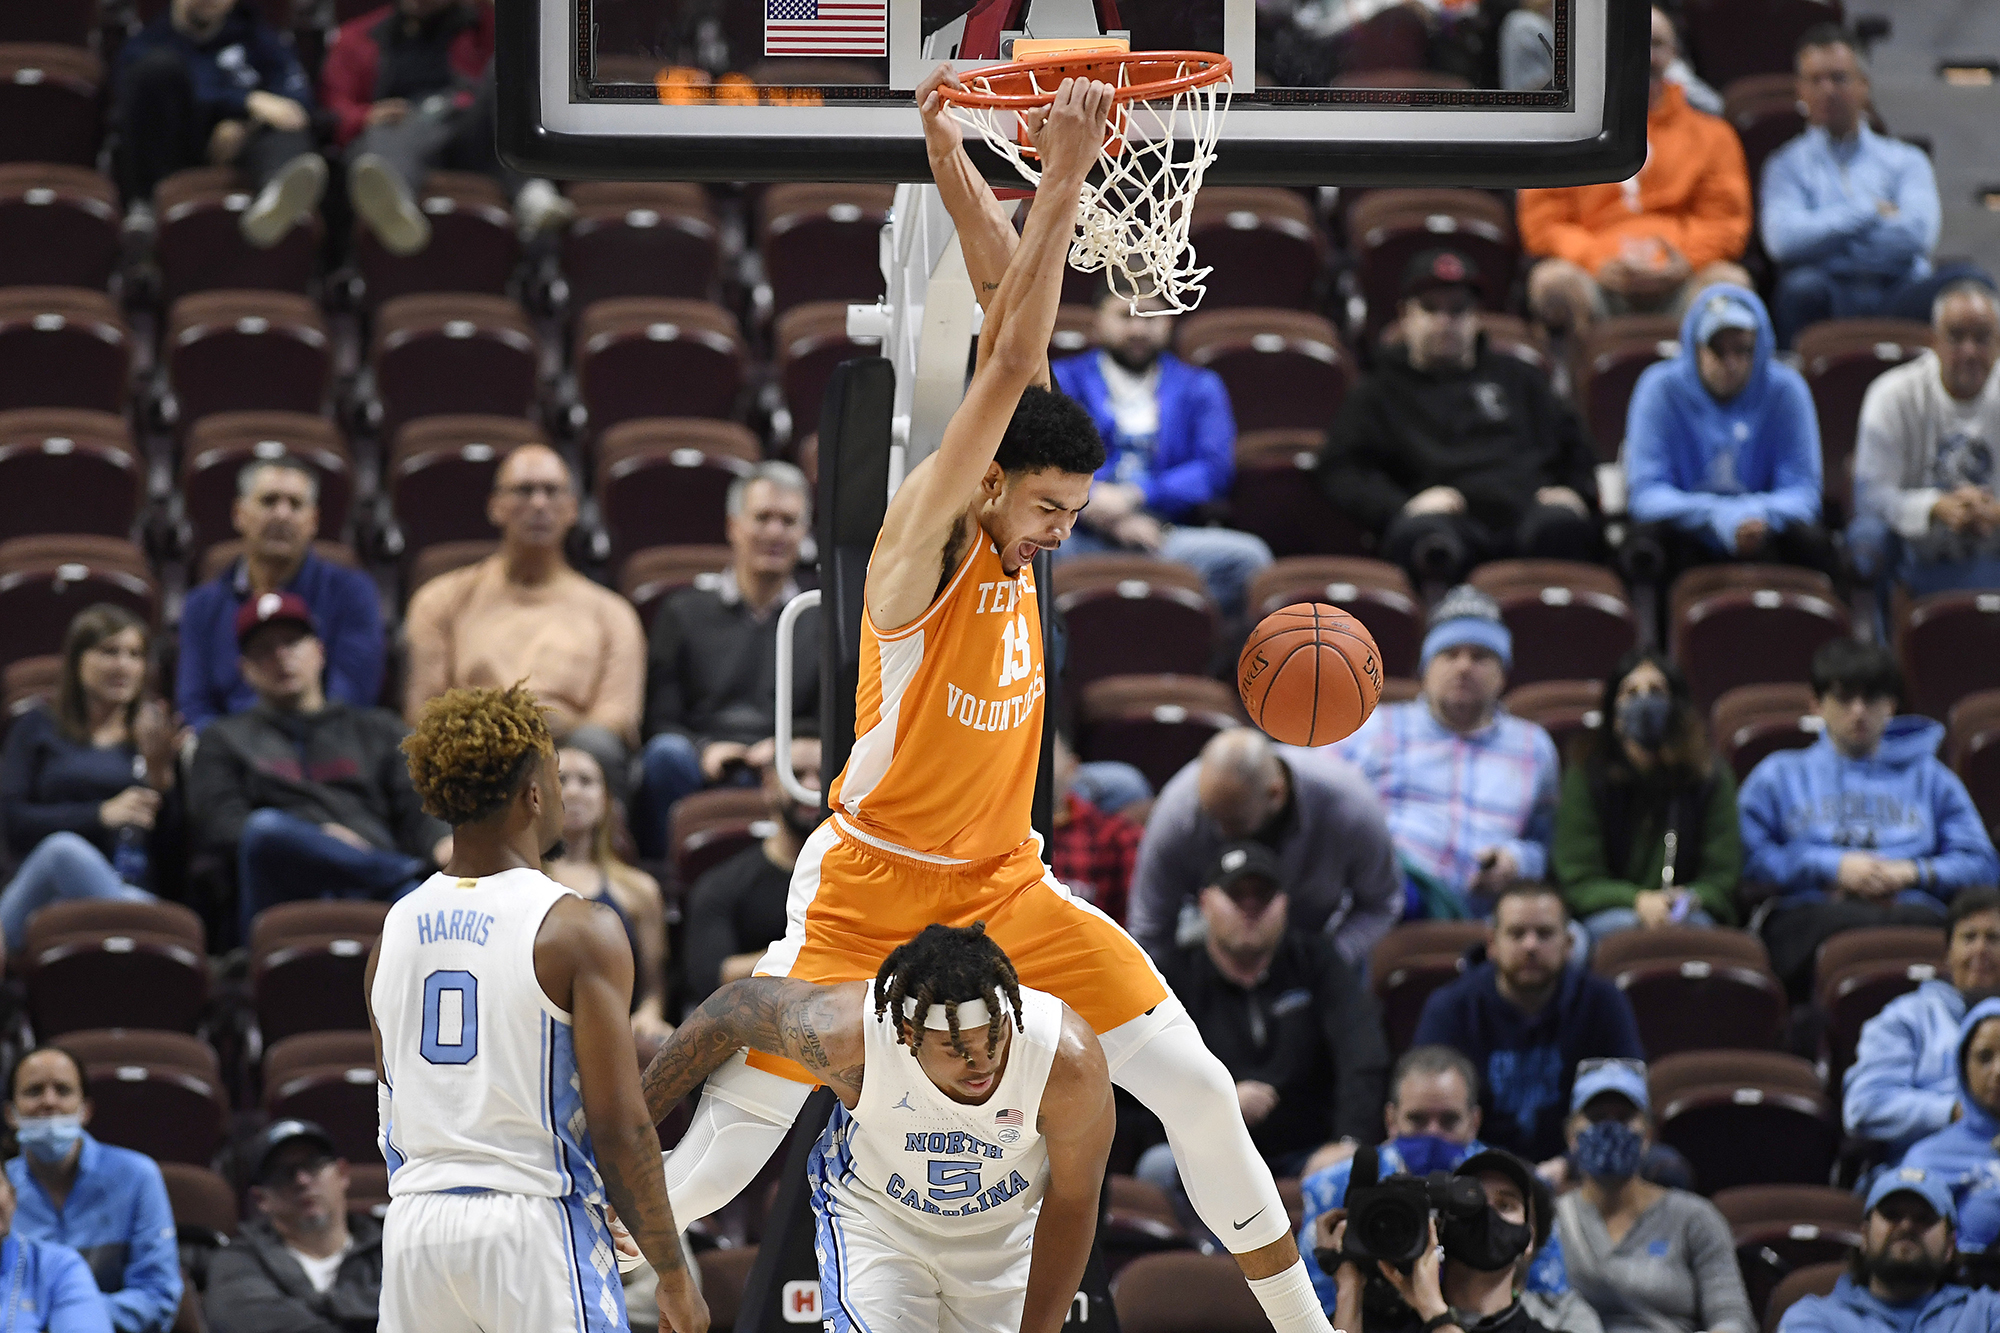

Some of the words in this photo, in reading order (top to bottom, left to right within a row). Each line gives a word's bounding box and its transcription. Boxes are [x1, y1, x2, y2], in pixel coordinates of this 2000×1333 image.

[417, 909, 495, 946] HARRIS
[420, 969, 478, 1065] 0
[904, 1130, 1004, 1160] NORTH
[927, 1159, 982, 1201] 5
